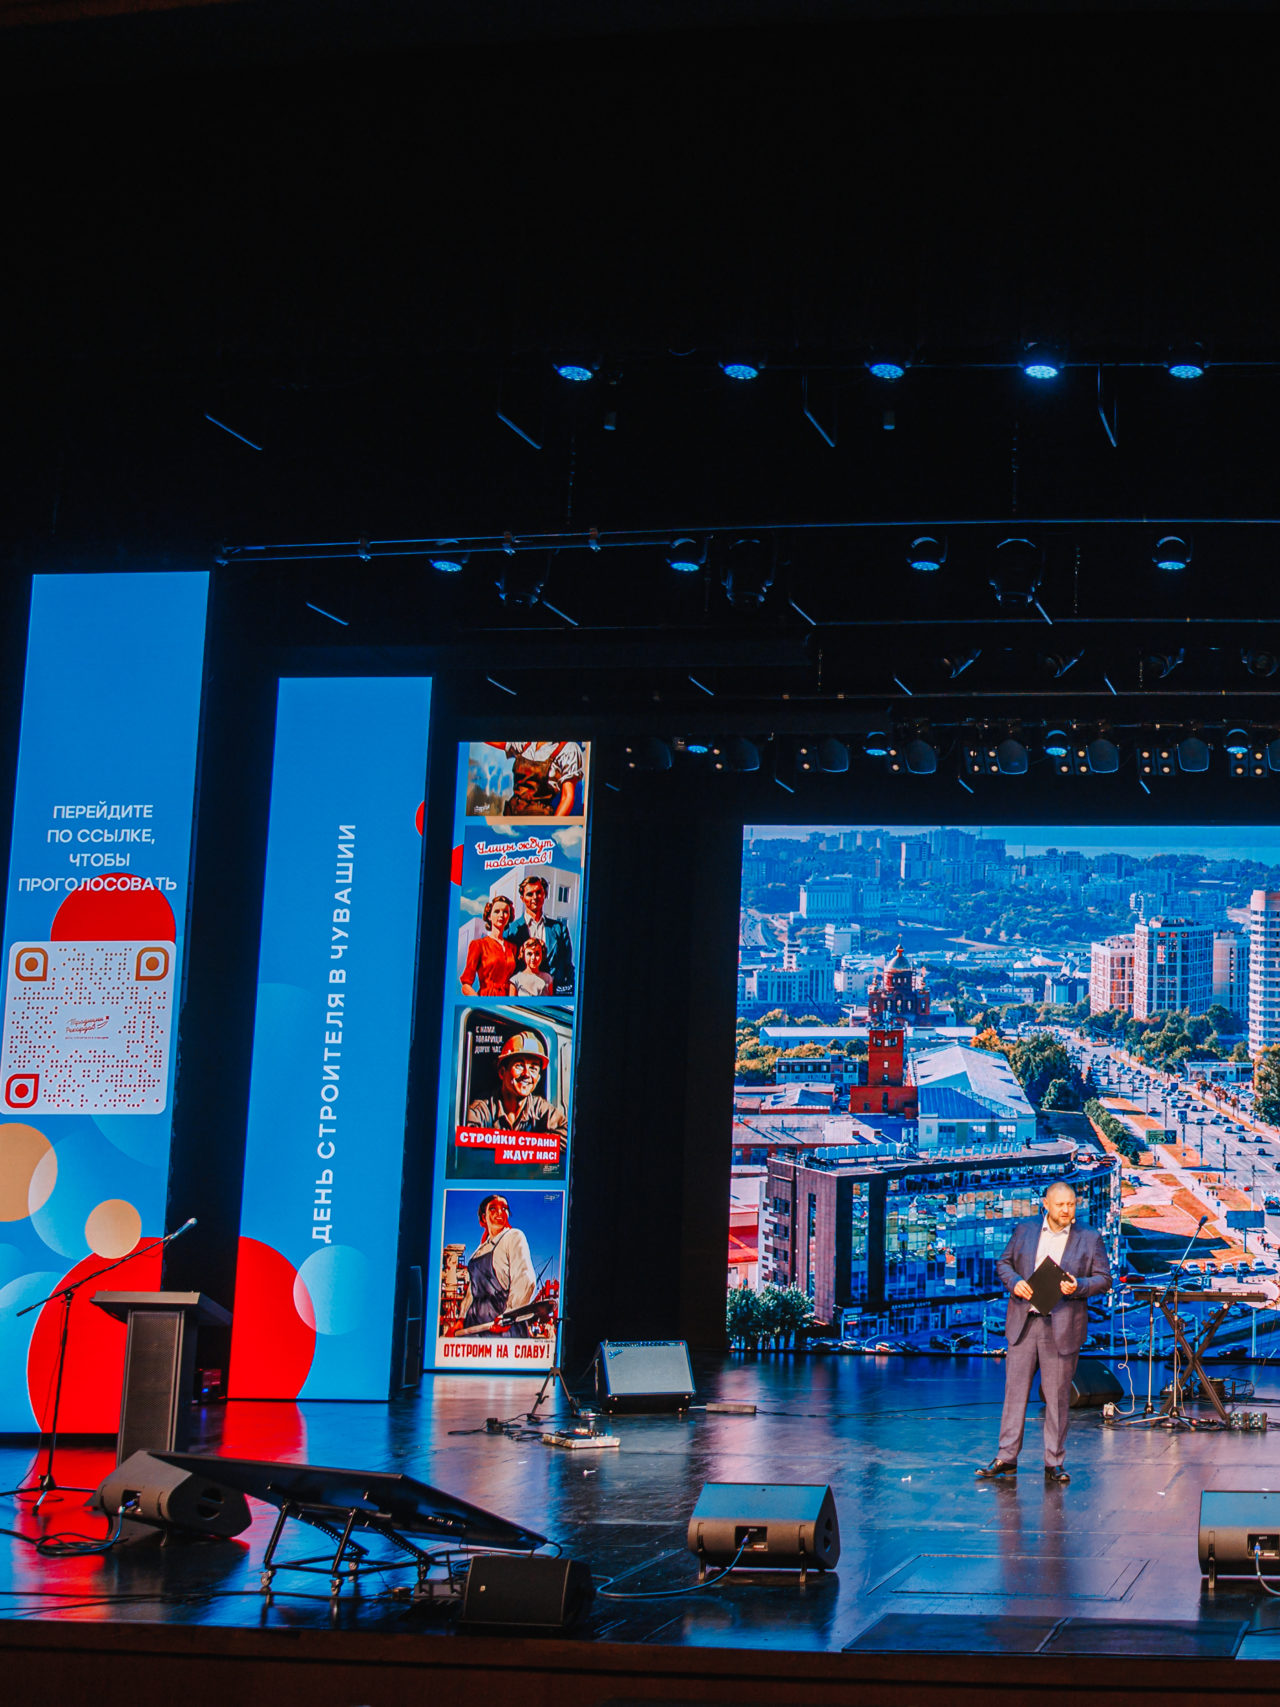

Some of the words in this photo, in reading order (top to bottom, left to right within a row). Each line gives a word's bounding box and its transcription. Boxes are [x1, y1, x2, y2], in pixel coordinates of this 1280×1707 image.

[53, 801, 154, 820] ПЕРЕЙДИТЕ
[47, 829, 73, 844] ПО
[77, 828, 156, 845] ССЫЛКЕ,
[475, 841, 516, 855] Улицы
[518, 837, 554, 854] ждут
[69, 853, 131, 868] ЧТОБЫ
[484, 850, 553, 869] новоселов!
[18, 876, 177, 892] ПРОГОЛОСОВАТЬ
[330, 824, 357, 960] ЧУВАШИИ
[328, 968, 347, 984] В
[316, 993, 346, 1160] СТРОИТЕЛЯ
[459, 1131, 516, 1146] СТРОЙКИ
[518, 1136, 557, 1147] СТРАНЫ
[502, 1150, 534, 1161] ЖДУТ
[536, 1151, 557, 1160] НАС!
[928, 1142, 1023, 1159] PALLADIUM
[311, 1168, 334, 1244] ДЕНЬ
[443, 1343, 492, 1358] ОТСТРОИМ
[496, 1344, 509, 1358] НА
[514, 1343, 550, 1359] СЛАВУ!
